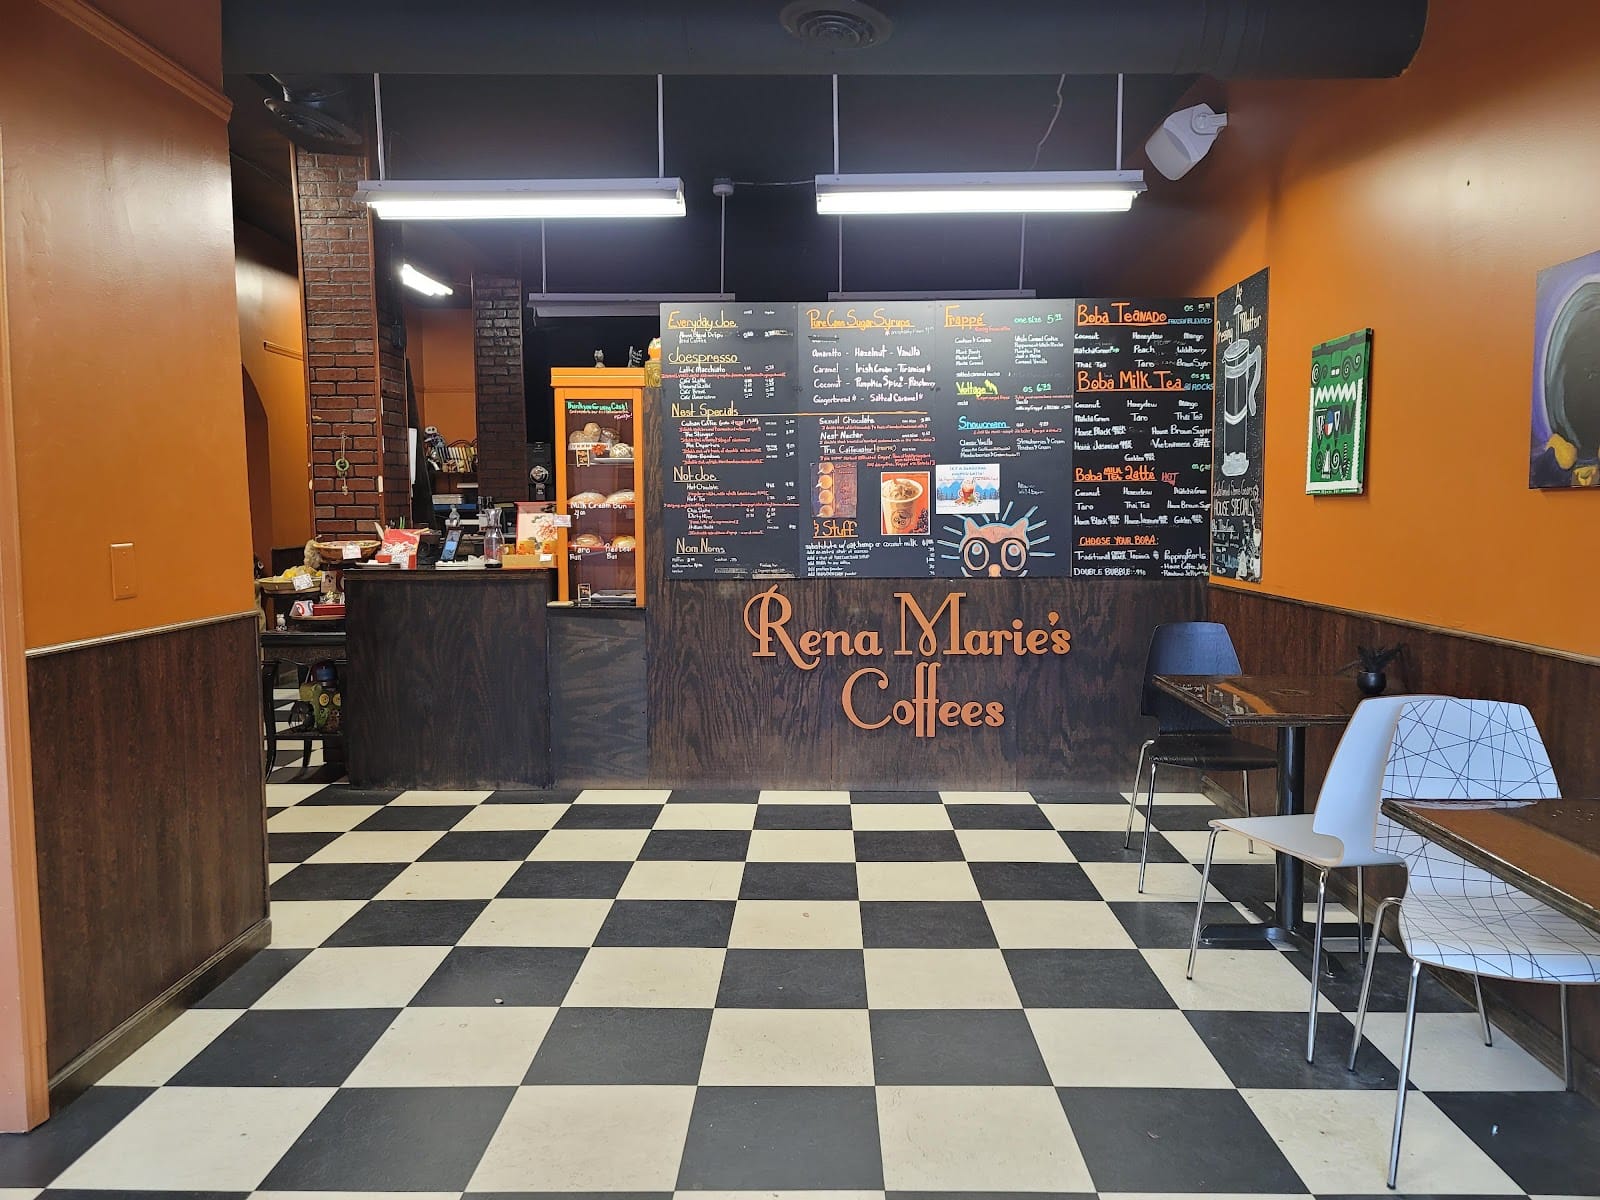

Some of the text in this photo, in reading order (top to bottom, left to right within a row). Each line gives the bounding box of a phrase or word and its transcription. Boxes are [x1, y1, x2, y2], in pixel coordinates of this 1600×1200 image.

[667, 309, 737, 331] Everyday Joe
[847, 309, 873, 331] Sugar
[873, 308, 910, 330] Syrups
[944, 304, 984, 330] Frappé
[1078, 304, 1109, 324] Boba
[1240, 306, 1261, 334] Matter
[1132, 332, 1163, 343] Honeydew
[812, 345, 920, 357] Amaretto Hazelnut Vanilla
[1133, 345, 1155, 353] Peach
[668, 346, 738, 368] Joespresso
[813, 363, 839, 373] Caramel
[855, 363, 873, 373] Irish
[814, 375, 842, 388] Coconut
[1078, 370, 1181, 390] Boba Milk Tea
[956, 382, 986, 397] Voltage
[870, 393, 893, 402] Salted
[893, 392, 919, 402] Caramel
[671, 400, 739, 421] Nest Specials
[1127, 400, 1157, 410] Honeydew
[842, 415, 875, 424] Chocolate
[958, 416, 1007, 430] Snowcream
[1130, 413, 1148, 421] Taro
[820, 430, 839, 440] Nest
[820, 445, 835, 453] The
[1075, 467, 1102, 480] Boba
[823, 520, 857, 536] Stuff
[701, 537, 726, 554] Noms
[1080, 536, 1110, 545] CHOOSE
[1114, 536, 1132, 544] YOUR
[744, 583, 1071, 670] Rena Marie's
[842, 661, 1005, 737] Coffees
